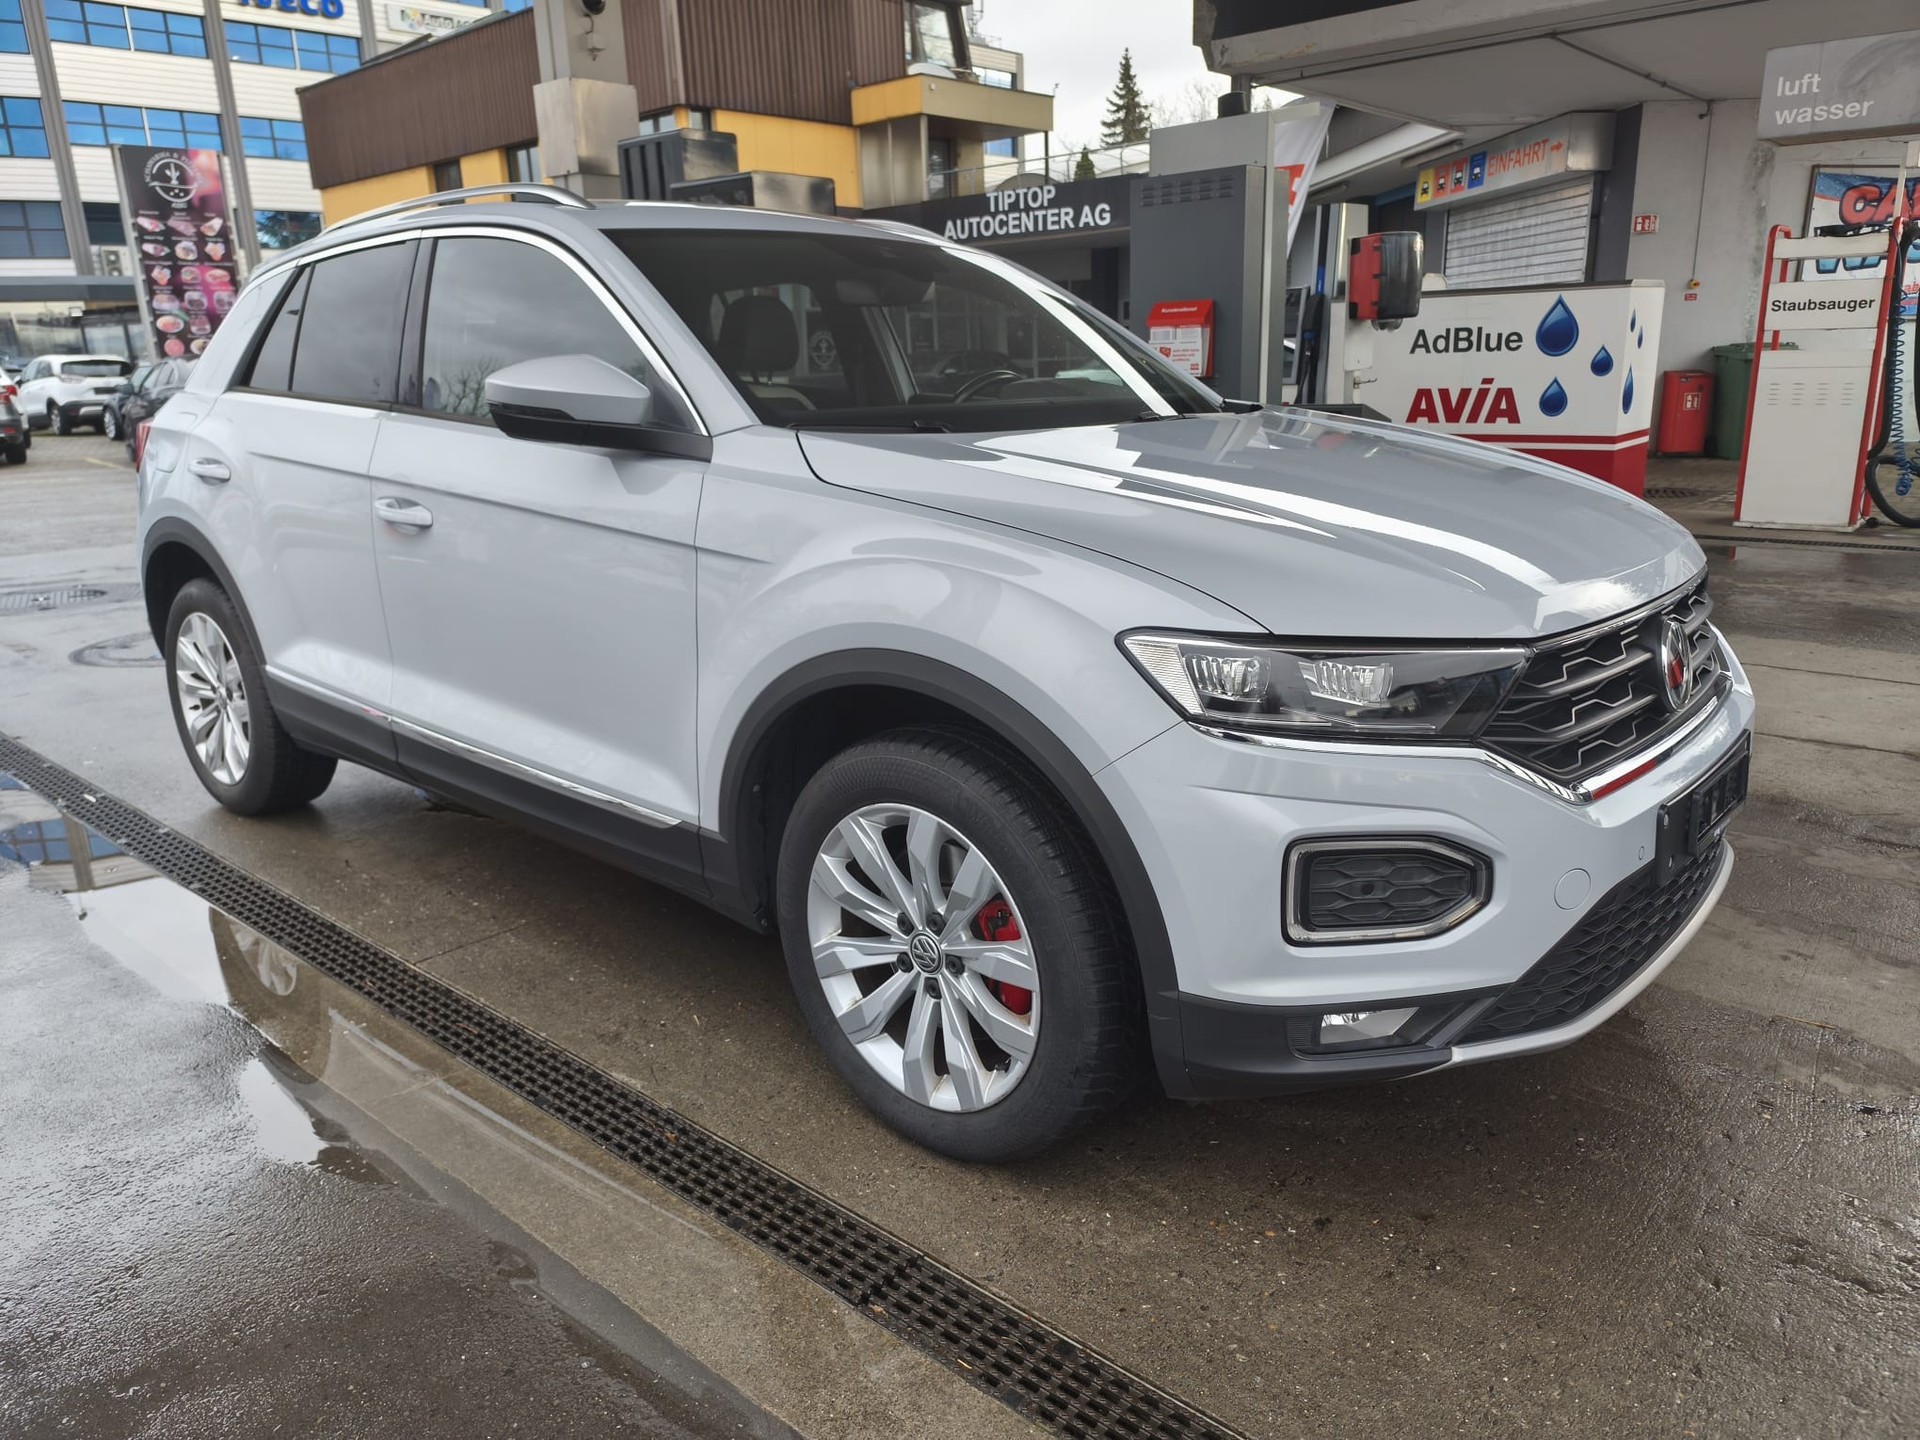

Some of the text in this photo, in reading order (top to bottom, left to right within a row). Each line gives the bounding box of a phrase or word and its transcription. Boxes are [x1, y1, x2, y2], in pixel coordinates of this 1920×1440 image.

[1776, 73, 1822, 98] luft
[1774, 100, 1875, 125] wasser
[1488, 138, 1550, 177] EINFAHRT
[986, 185, 1056, 213] TIPTOP
[1839, 183, 1920, 226] CA
[943, 203, 1112, 240] AUTOCENTER AG
[1771, 299, 1876, 313] Staubsauger
[1409, 326, 1523, 354] AdBlue
